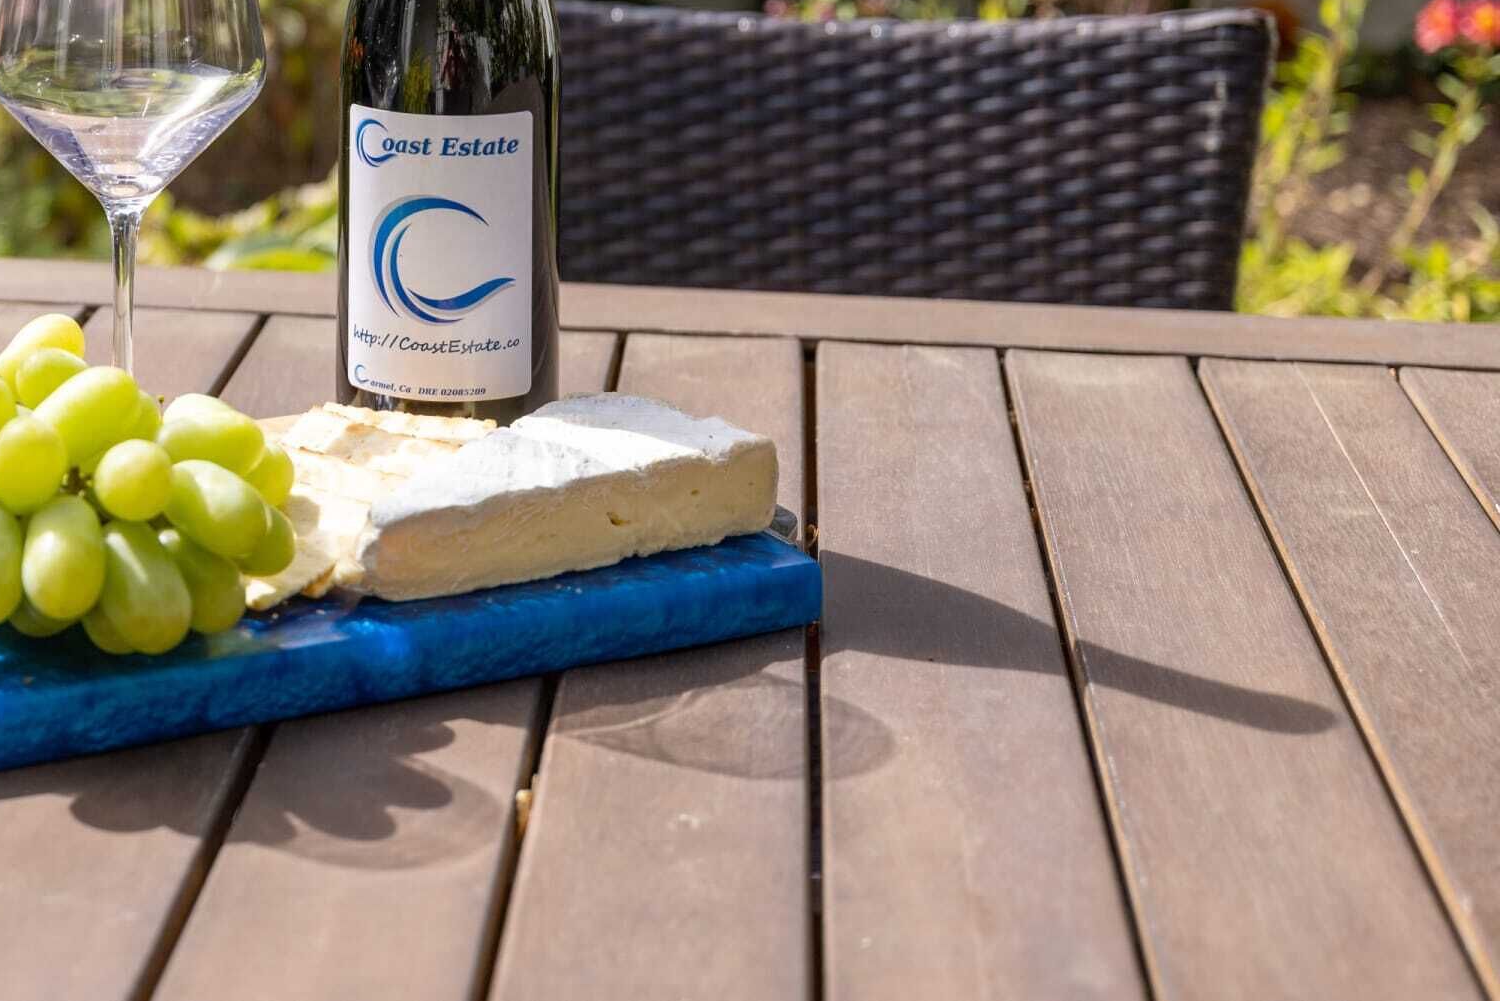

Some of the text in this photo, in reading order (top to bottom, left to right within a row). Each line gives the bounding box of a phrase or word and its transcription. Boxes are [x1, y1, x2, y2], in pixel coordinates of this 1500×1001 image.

[356, 117, 519, 168] Coast Estate
[353, 323, 520, 356] http://CoastEstate.co
[398, 384, 412, 394] Ca
[418, 386, 438, 396] DRE
